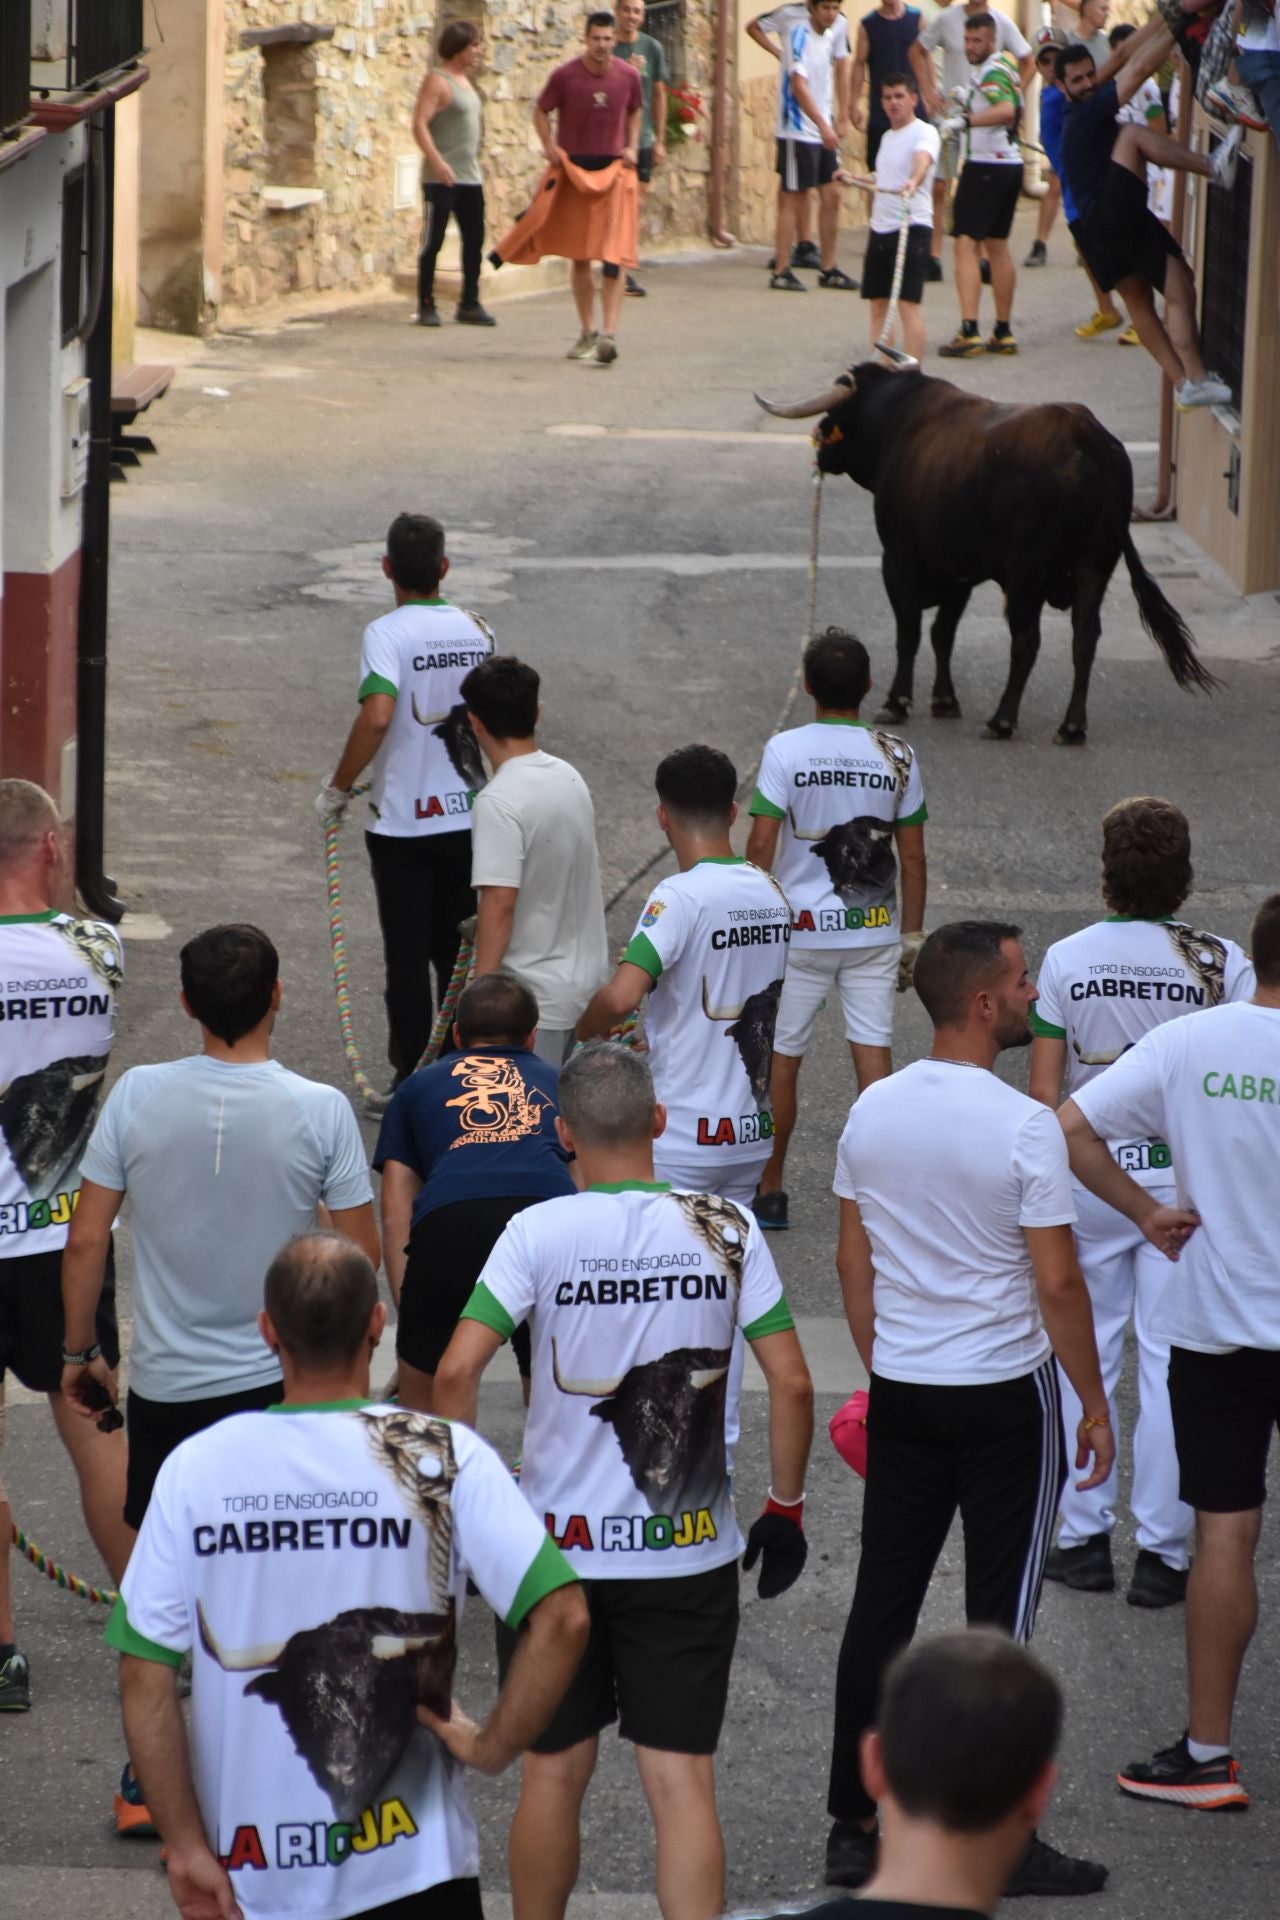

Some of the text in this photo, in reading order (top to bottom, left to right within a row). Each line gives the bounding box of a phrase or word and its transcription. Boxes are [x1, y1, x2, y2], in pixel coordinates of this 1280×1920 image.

[809, 757, 884, 770] TORO ENSOGADO
[794, 771, 897, 792] CABRETON
[415, 789, 480, 819] LA RIO
[728, 909, 748, 922] TORO
[820, 904, 892, 932] RIOJA
[711, 923, 791, 950] CABRETO
[7, 977, 88, 993] ENSOGADO
[1088, 964, 1185, 978] TORO ENSOGADO
[1070, 978, 1204, 1006] CABRETON
[0, 994, 109, 1023] RETON
[1203, 1071, 1280, 1105] CABR
[697, 1110, 777, 1146] LA RIO
[1118, 1144, 1172, 1171] RIO
[0, 1189, 80, 1235] RIOJ
[579, 1253, 701, 1273] TORO ENSOGADO
[555, 1274, 727, 1306] CABRETON
[223, 1490, 378, 1513] TORO ENSOGADO
[193, 1517, 412, 1557] CABRETON
[602, 1507, 718, 1551] RIOJA
[276, 1797, 418, 1868] RIOJA
